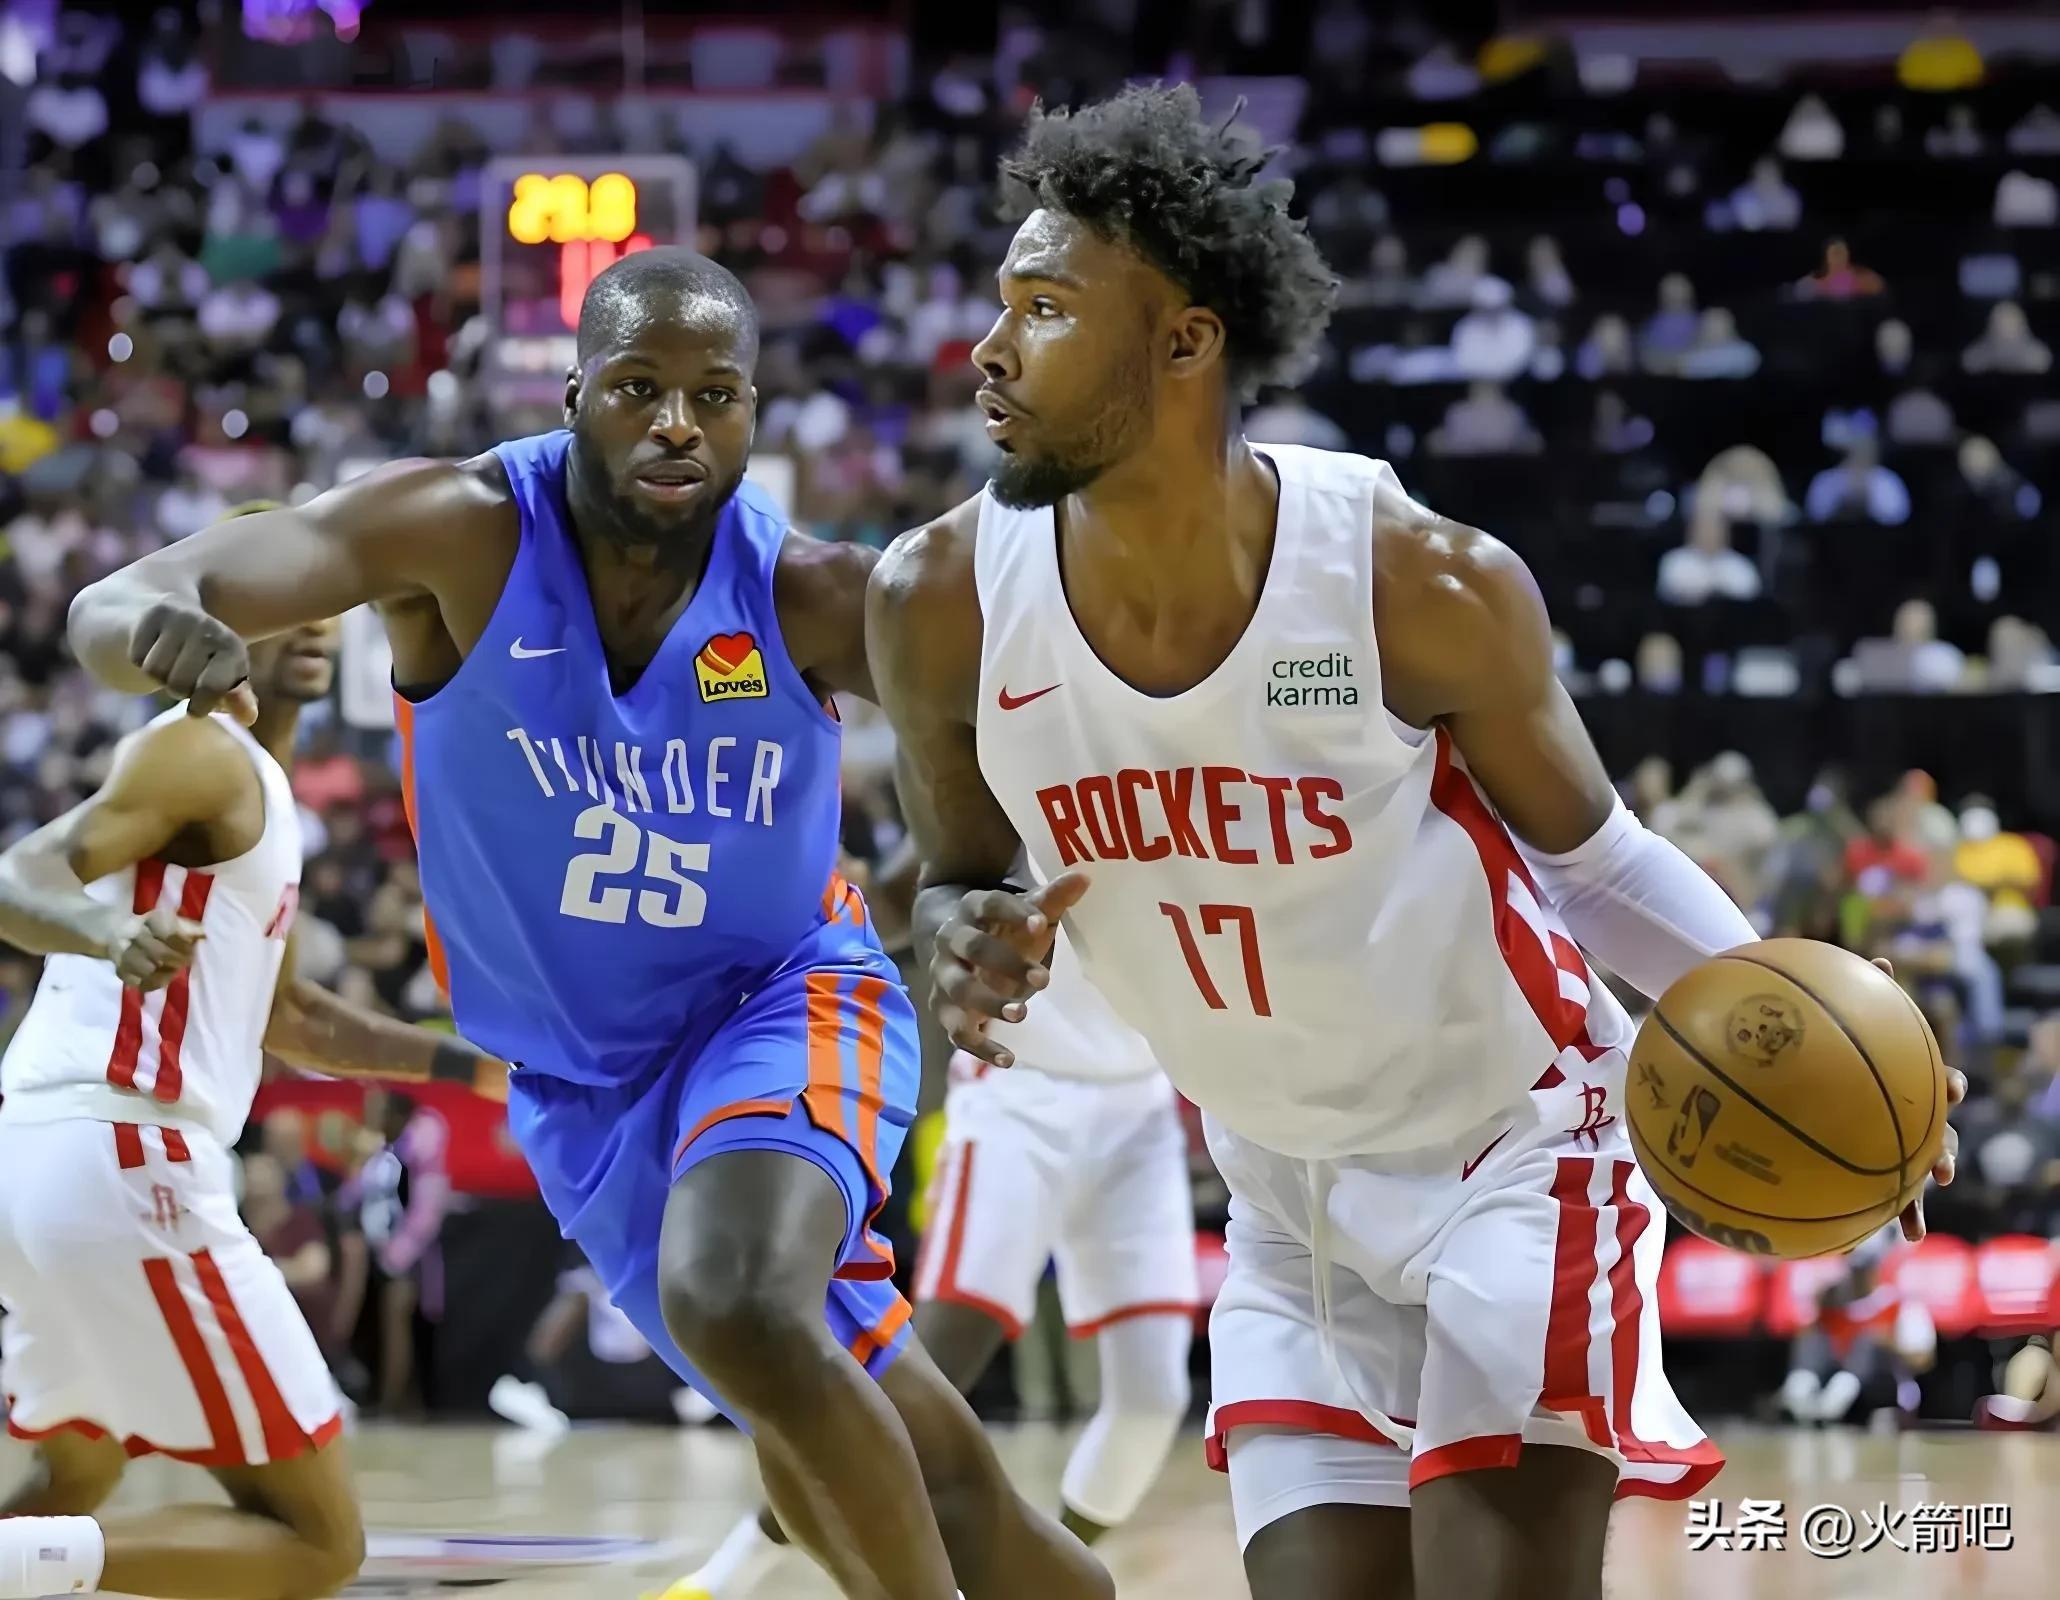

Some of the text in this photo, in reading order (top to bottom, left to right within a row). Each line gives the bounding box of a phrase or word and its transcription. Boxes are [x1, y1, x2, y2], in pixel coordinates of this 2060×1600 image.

[1267, 682, 1358, 706] karma
[1272, 653, 1353, 678] credit
[560, 804, 711, 928] 25
[1036, 766, 1353, 867] ROCKETS
[1158, 902, 1272, 1017] 17
